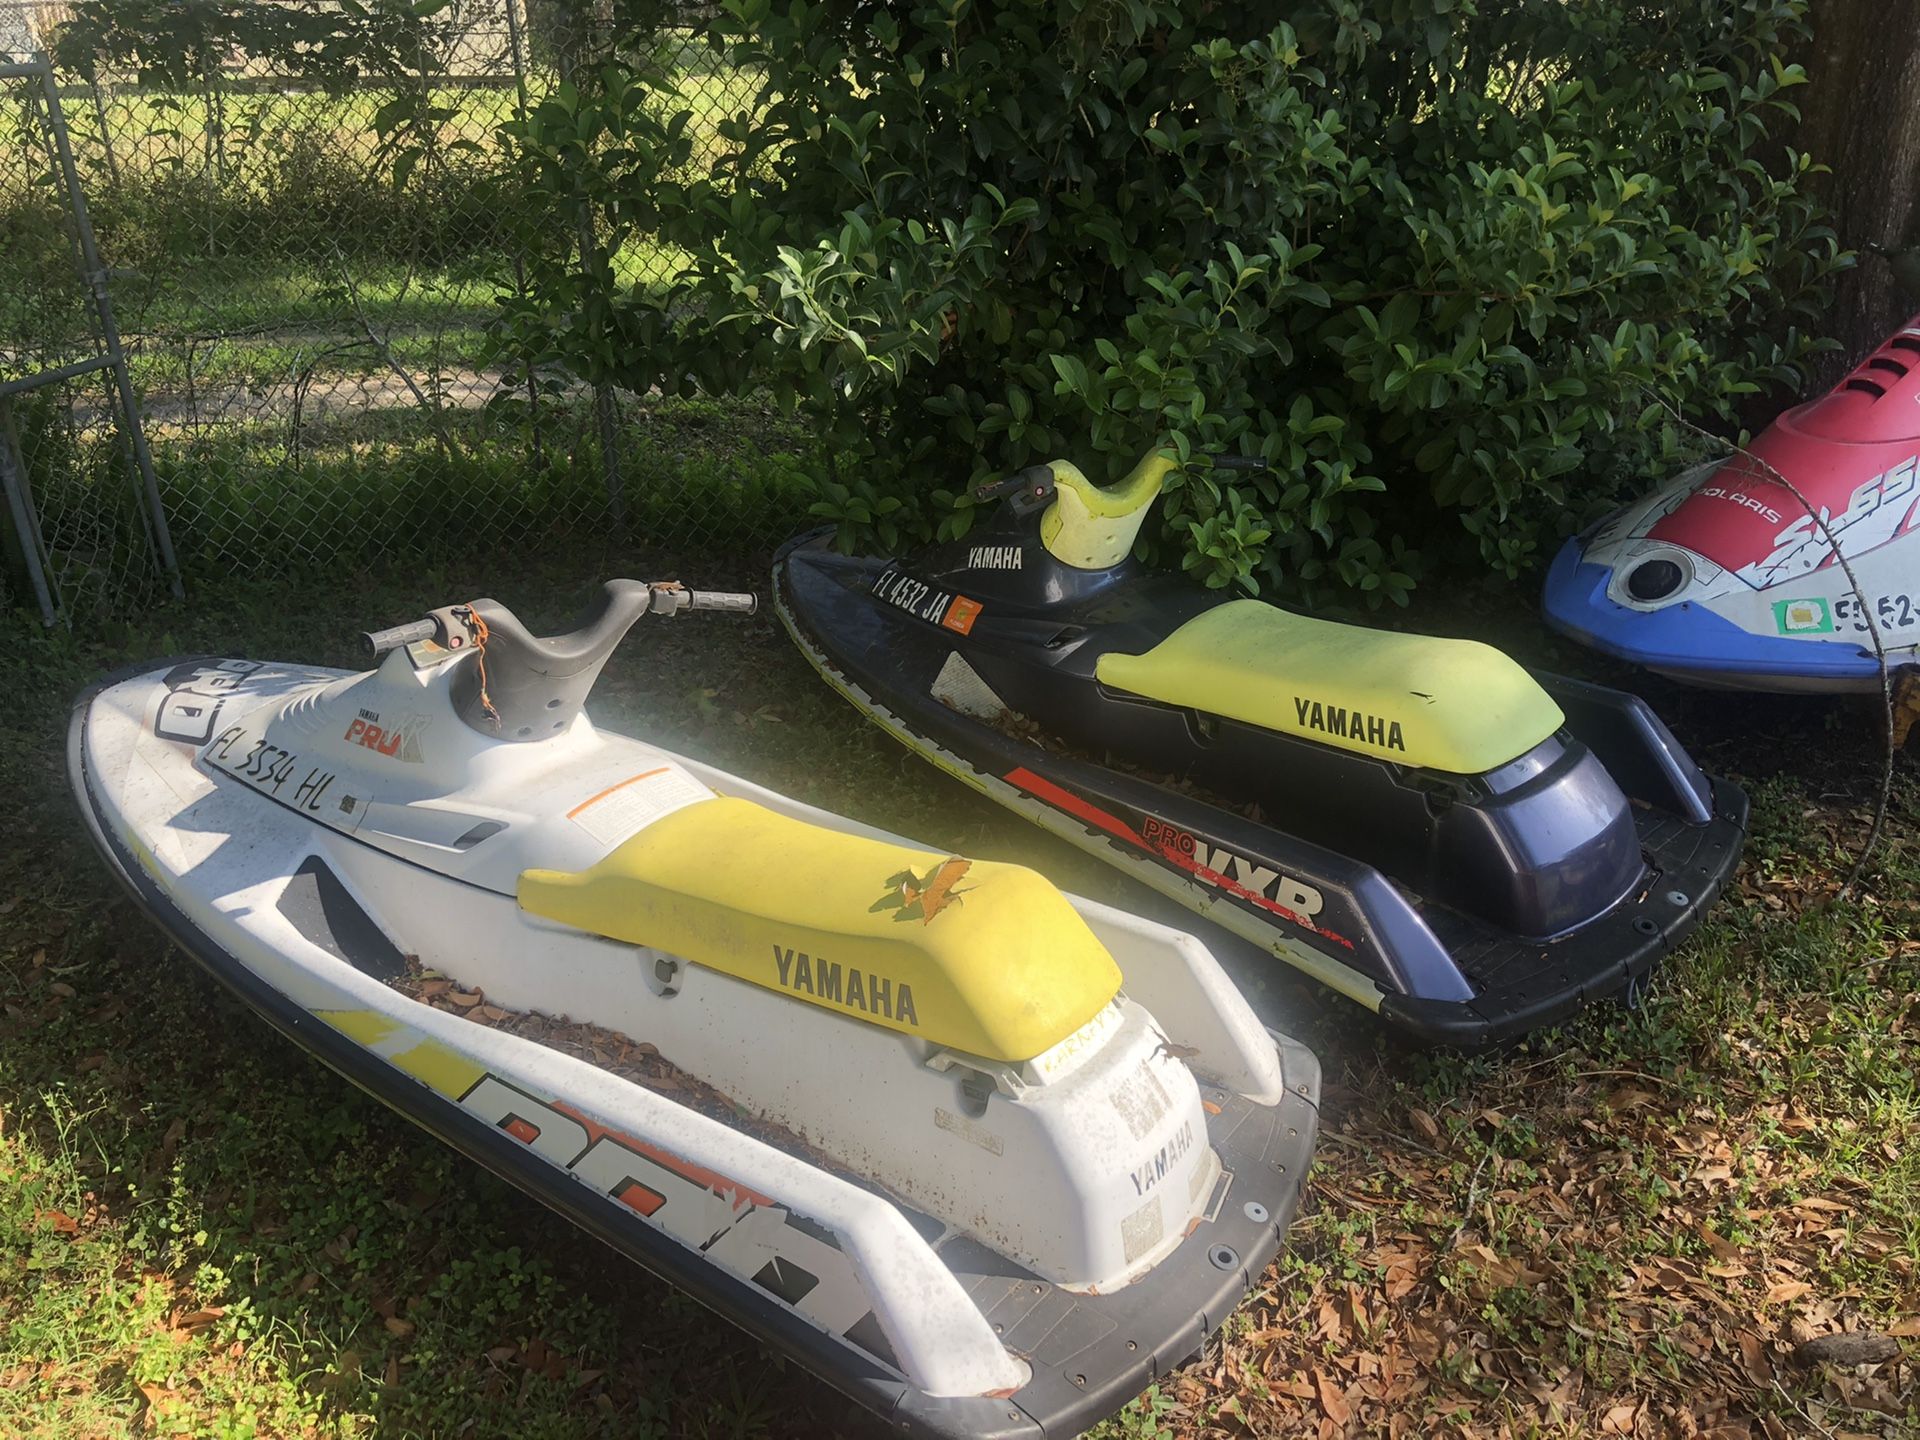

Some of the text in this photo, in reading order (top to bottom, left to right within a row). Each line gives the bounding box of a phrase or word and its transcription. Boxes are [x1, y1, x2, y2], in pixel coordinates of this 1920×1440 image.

[1846, 454, 1920, 513] 65
[967, 547, 1022, 569] YAMAHA
[872, 569, 950, 624] FL 4532 JA
[1294, 696, 1406, 752] YAMAHA
[208, 726, 335, 811] FL 3534 HL
[1142, 817, 1324, 933] PRO VXR
[773, 944, 919, 1026] YAMAHA
[1130, 1119, 1194, 1196] YAMAHA
